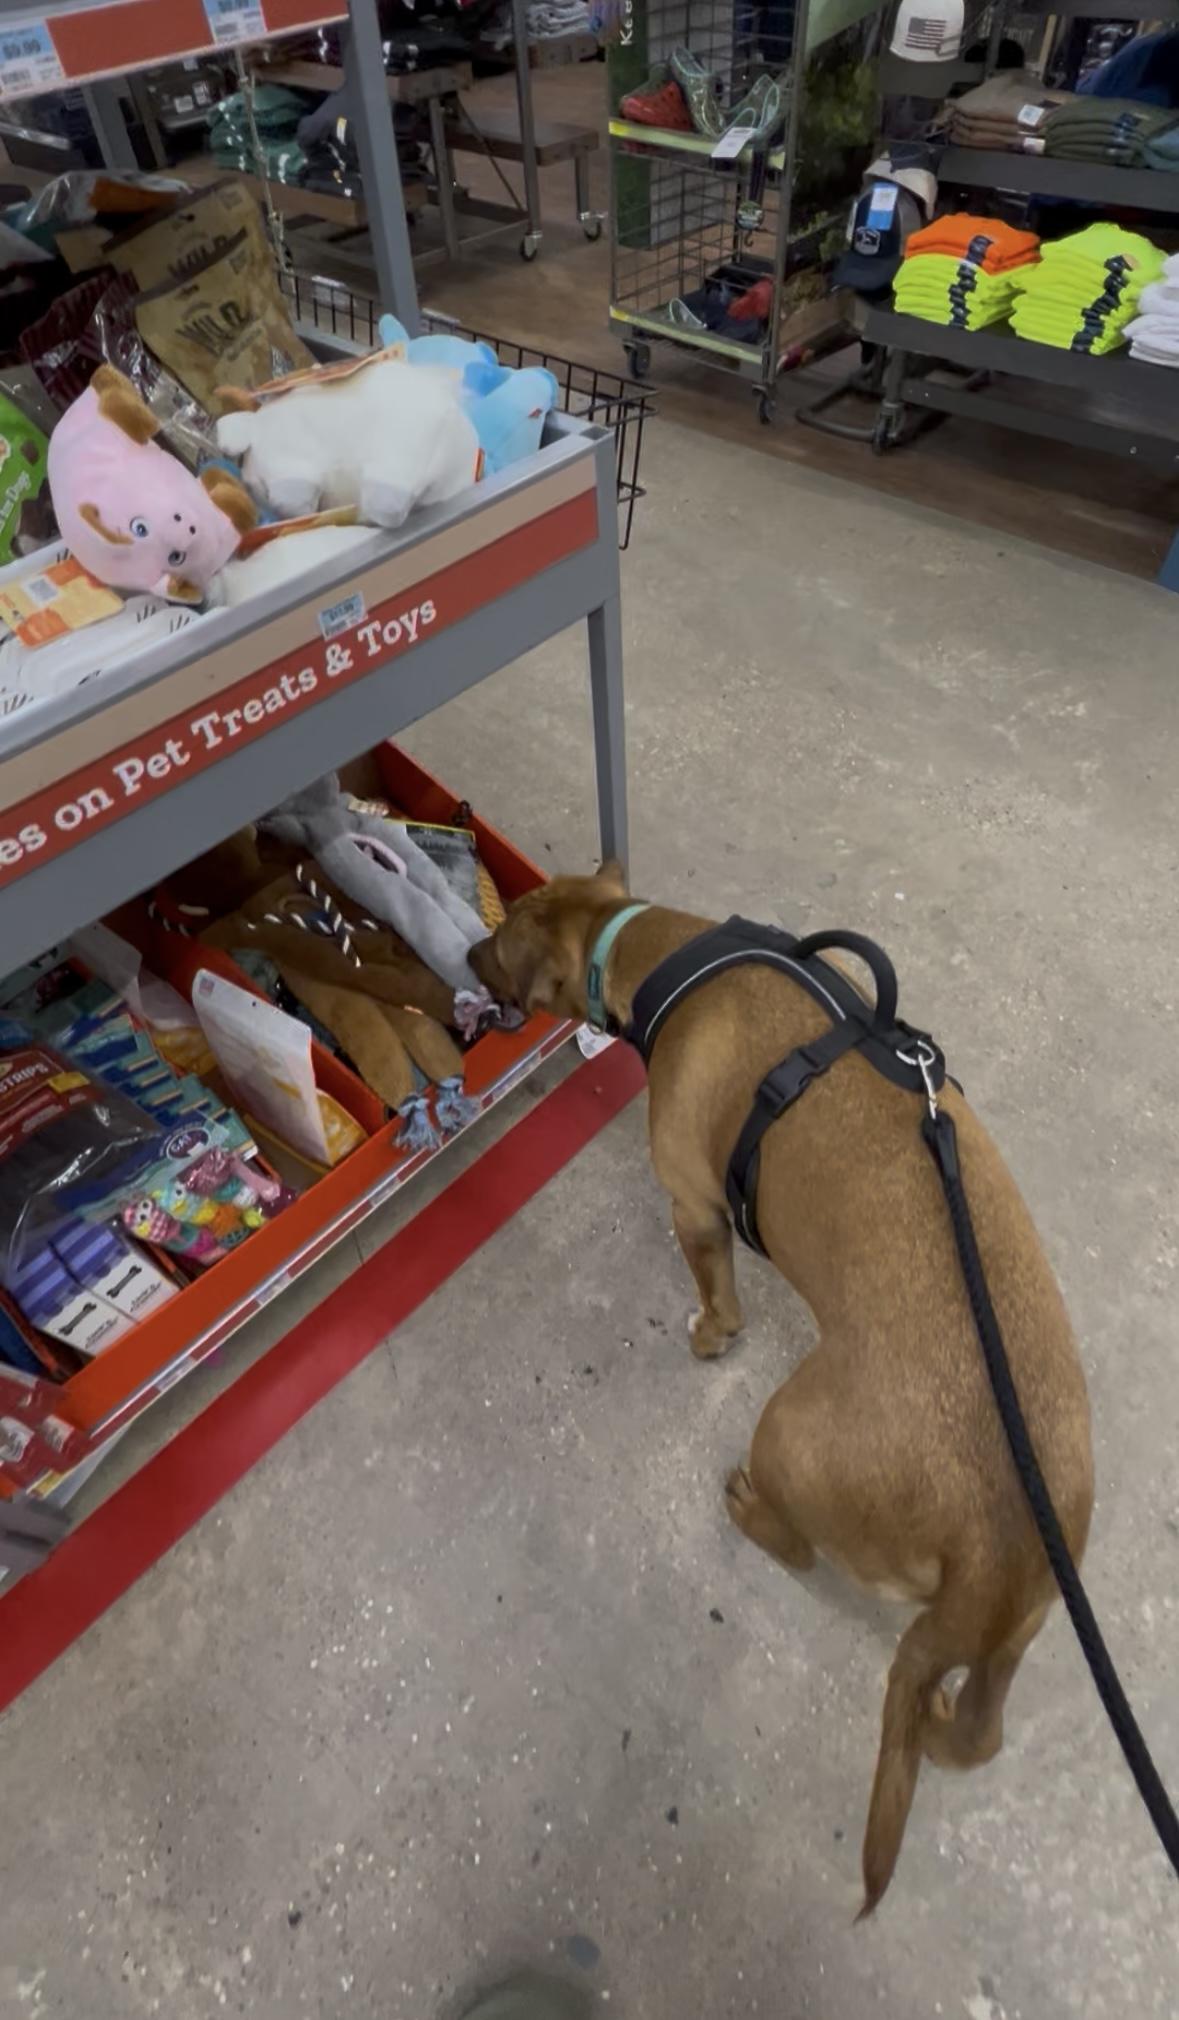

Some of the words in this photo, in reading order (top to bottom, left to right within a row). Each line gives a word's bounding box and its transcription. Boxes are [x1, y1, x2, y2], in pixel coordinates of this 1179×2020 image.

[0, 824, 48, 866] es
[54, 787, 115, 831] on
[112, 739, 191, 797] Pet
[190, 666, 318, 750] Treats
[326, 643, 354, 678] &
[357, 599, 437, 657] Toys
